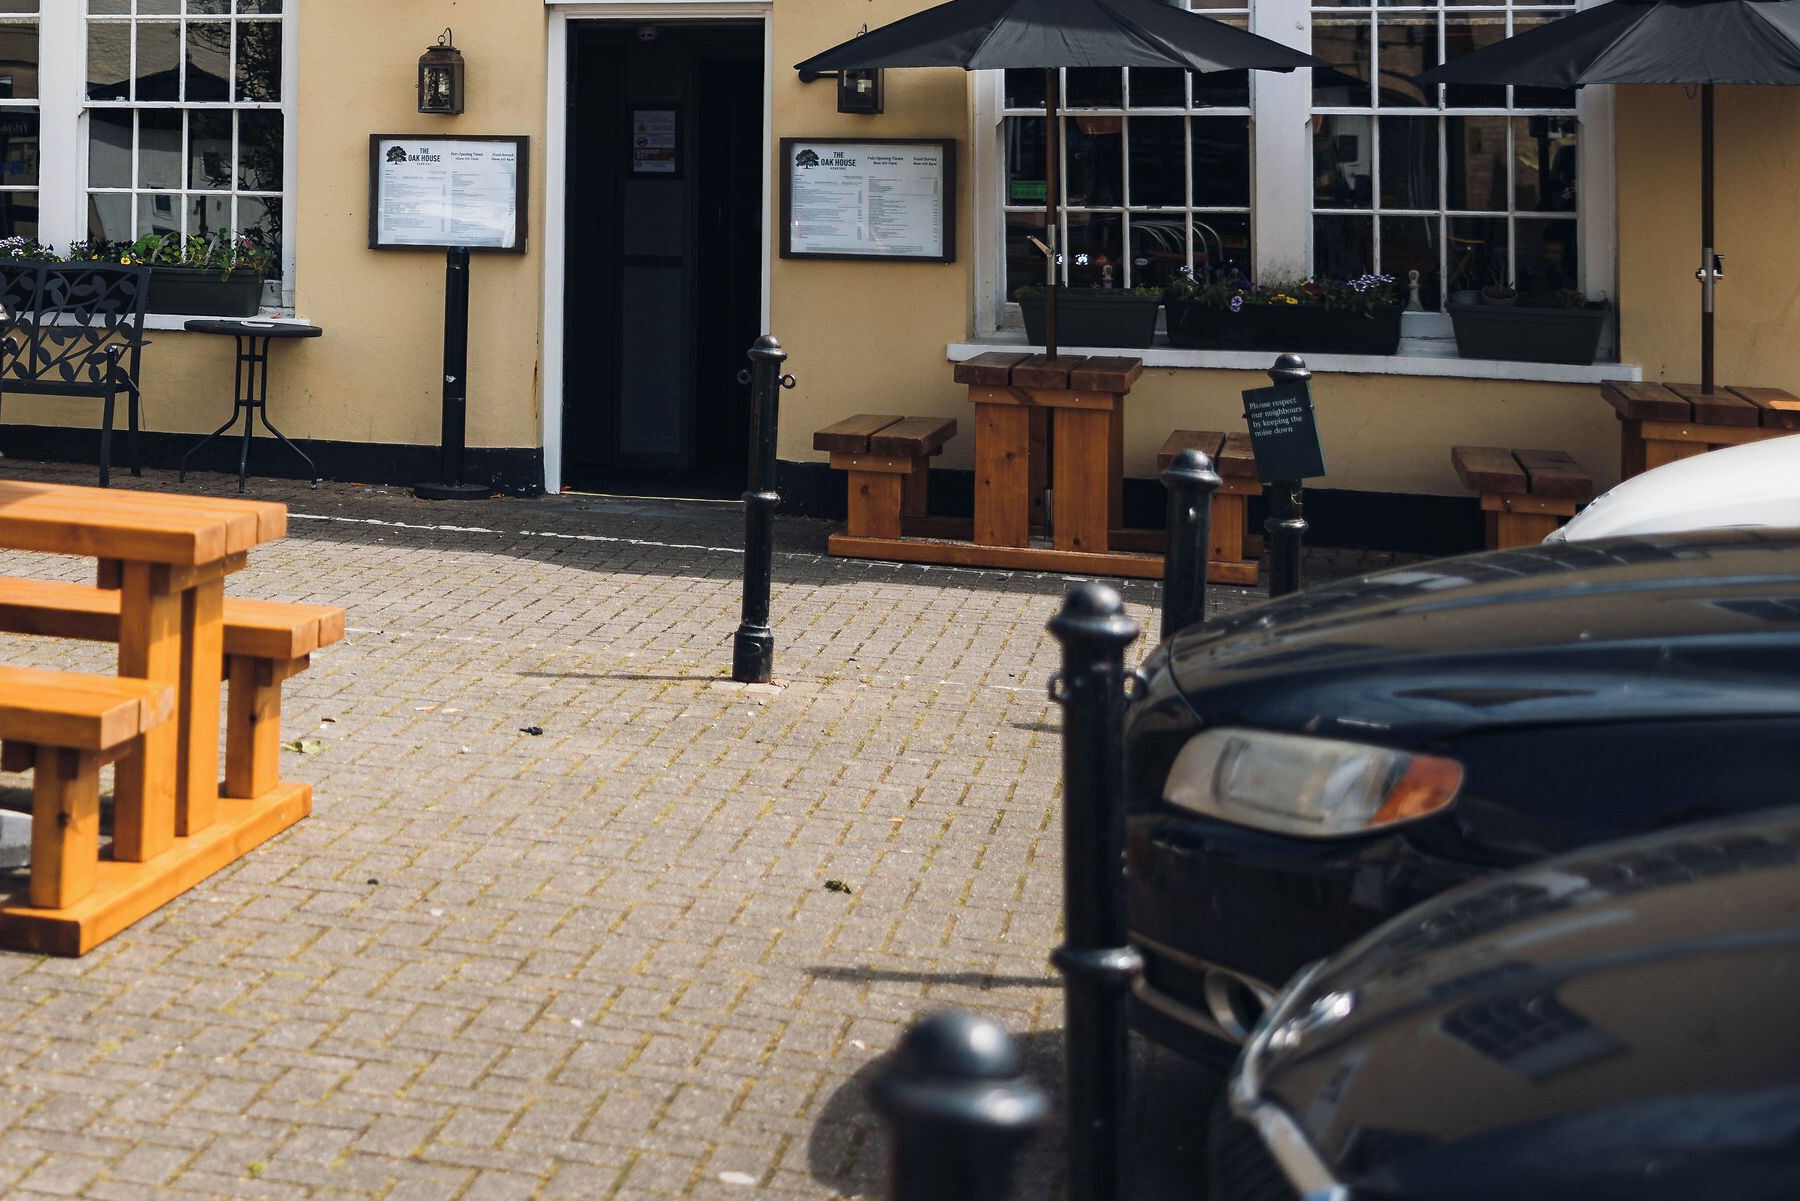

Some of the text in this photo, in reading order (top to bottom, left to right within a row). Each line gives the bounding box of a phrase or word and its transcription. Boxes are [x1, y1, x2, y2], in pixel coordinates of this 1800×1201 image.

[408, 154, 441, 162] OAK HOUSE
[835, 159, 856, 167] HOUSE
[1272, 398, 1296, 407] respect
[1251, 407, 1302, 419] our neighbours
[1253, 415, 1303, 429] by keeping the
